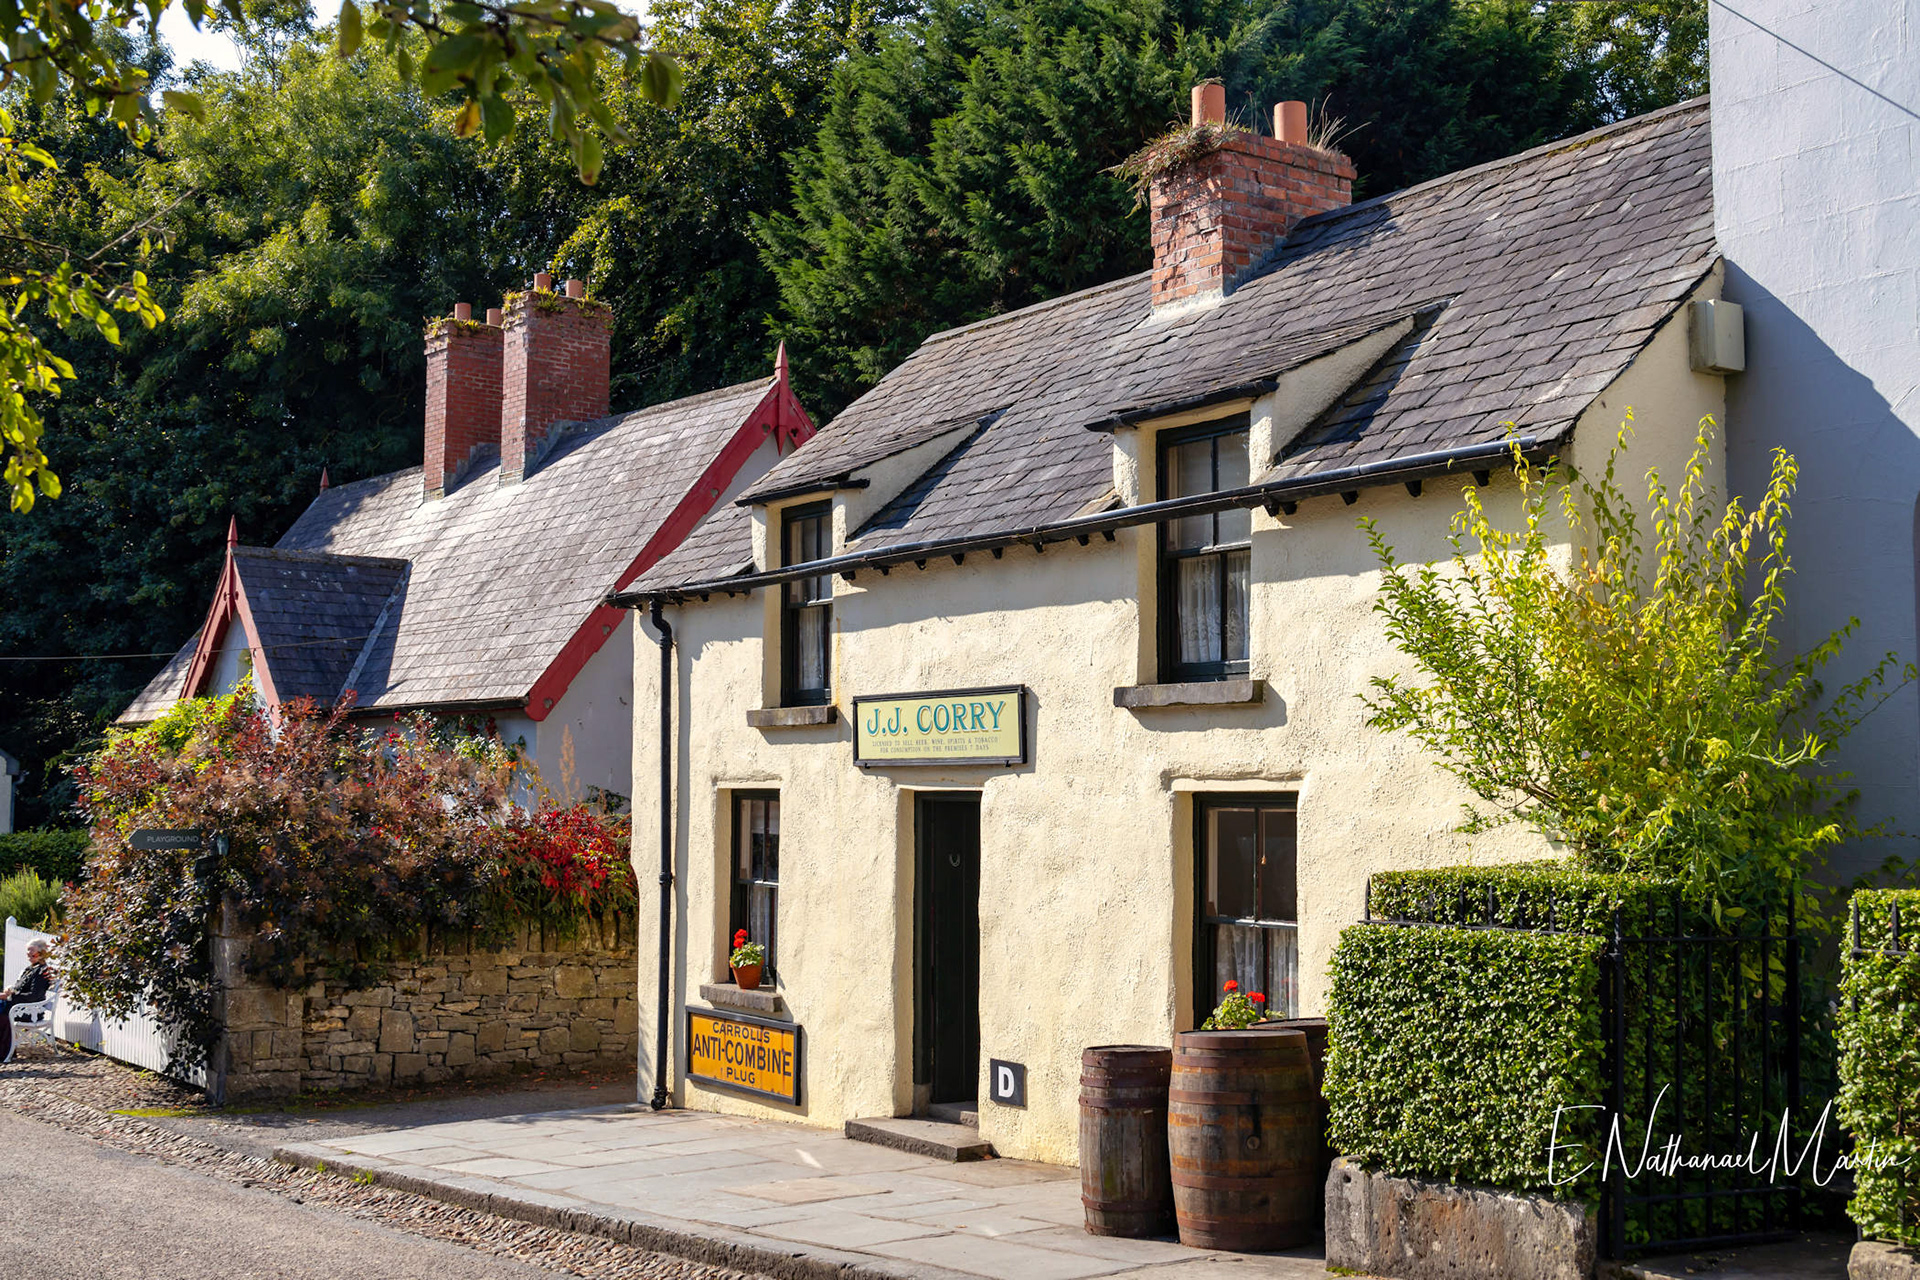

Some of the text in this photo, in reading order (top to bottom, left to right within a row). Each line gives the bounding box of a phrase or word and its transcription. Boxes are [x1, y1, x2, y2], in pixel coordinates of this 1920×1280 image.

[867, 700, 1006, 735] J.J. CORRY
[147, 835, 199, 844] PLAYGROUND
[692, 1033, 792, 1077] ANTI-COMBINE
[726, 1067, 755, 1084] PLUG
[998, 1065, 1015, 1098] D
